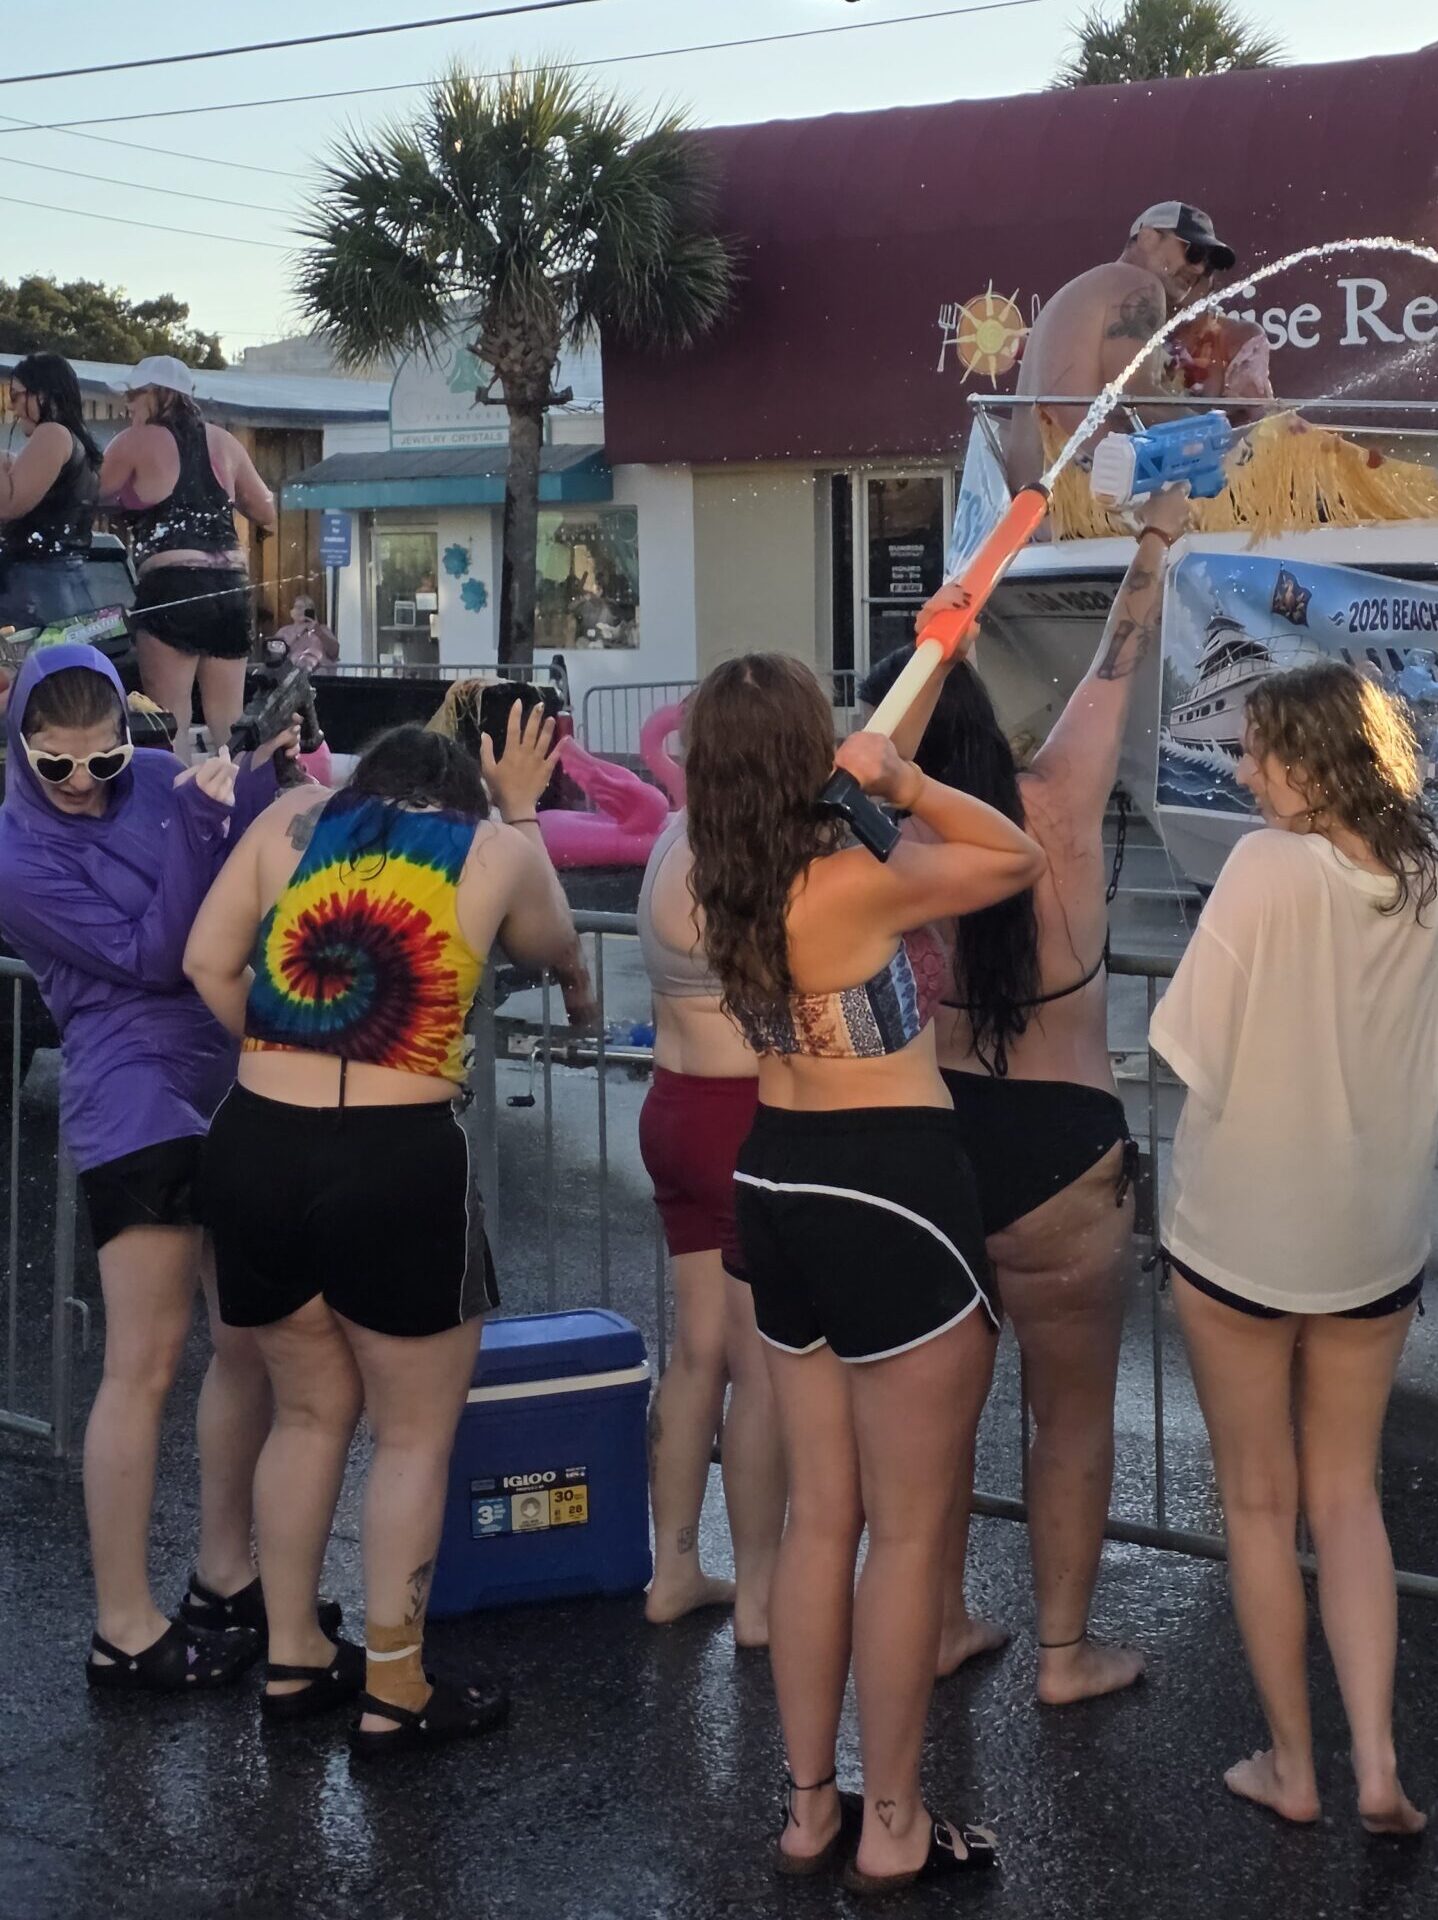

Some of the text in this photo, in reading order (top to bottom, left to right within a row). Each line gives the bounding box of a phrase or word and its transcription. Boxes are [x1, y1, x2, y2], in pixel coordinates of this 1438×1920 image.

[400, 432, 504, 445] JEWELRY CRYSTALS
[1348, 598, 1389, 633] 2026
[503, 1471, 557, 1488] IGLOO
[554, 1490, 574, 1503] 30
[477, 1505, 494, 1525] 3
